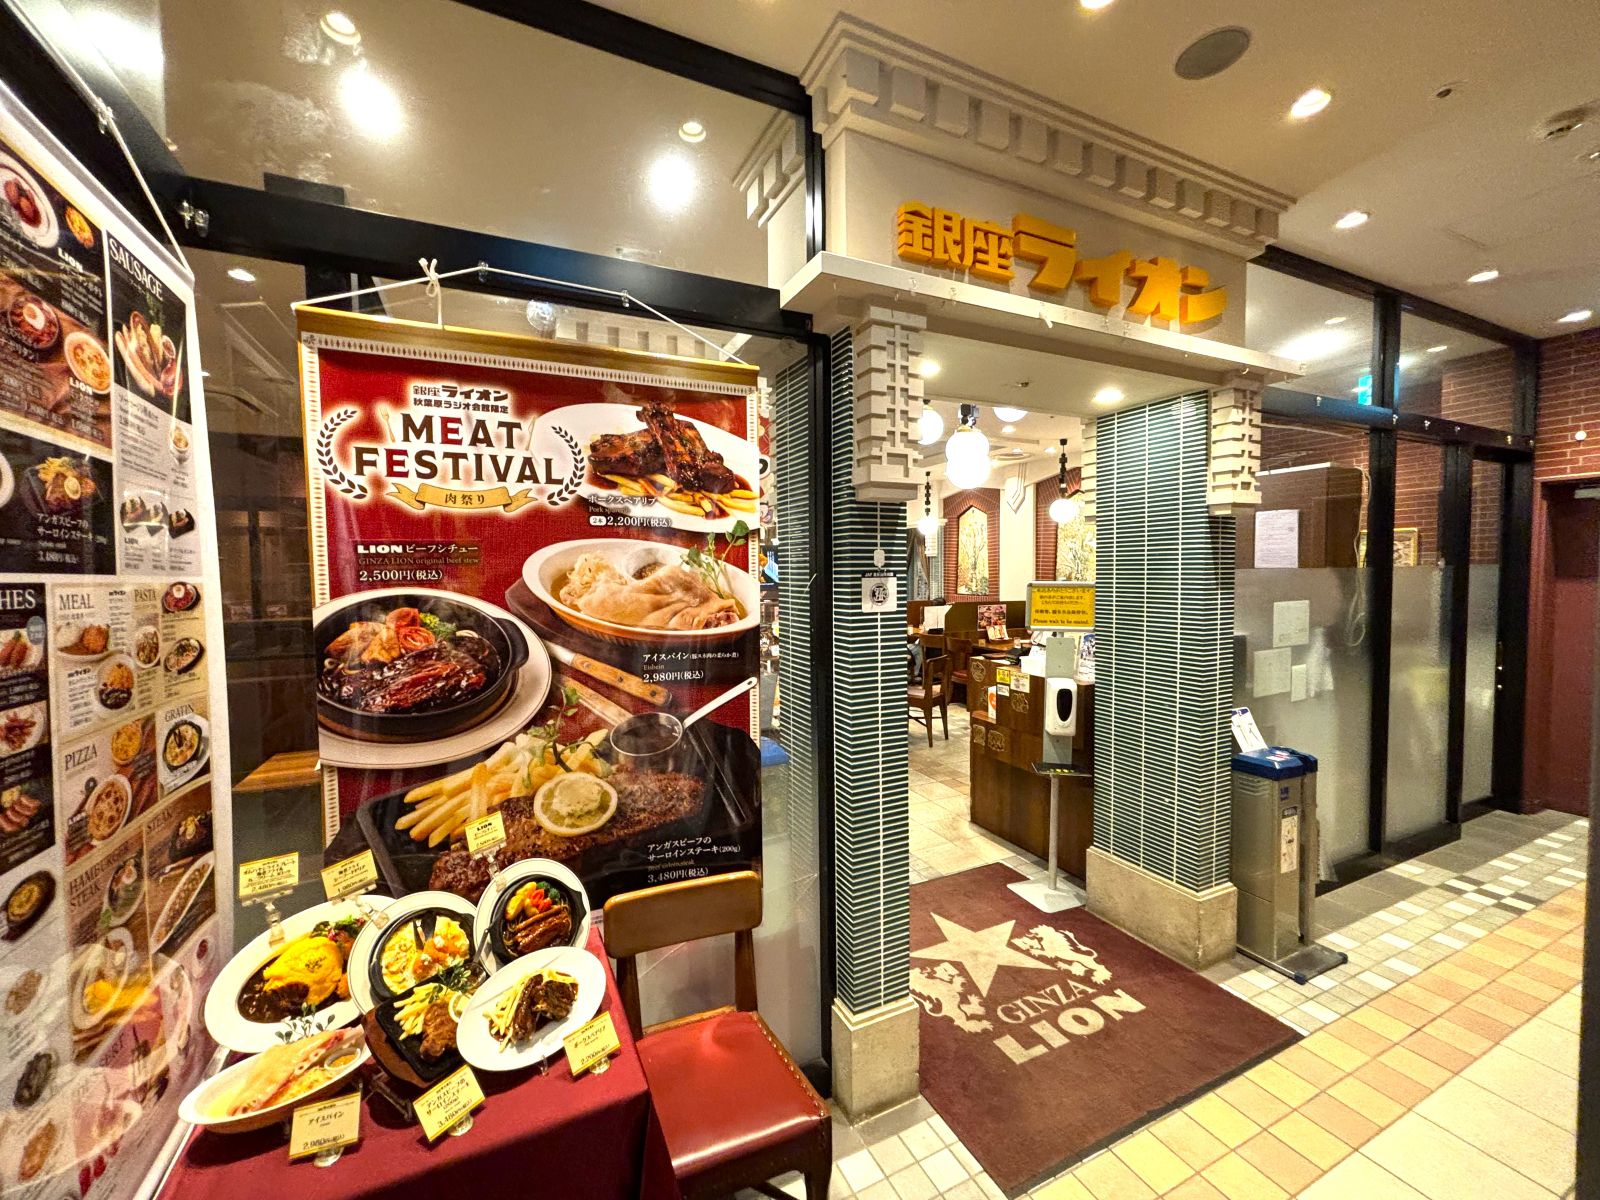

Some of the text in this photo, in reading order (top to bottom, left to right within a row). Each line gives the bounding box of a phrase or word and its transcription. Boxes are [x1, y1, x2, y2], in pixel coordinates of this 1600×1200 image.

[58, 247, 84, 273] LION
[897, 199, 1227, 325] 銀座ライオン
[109, 238, 164, 302] SAUSAGE
[69, 377, 94, 396] LION
[413, 384, 508, 402] 銀座ライオン
[413, 398, 509, 414] 秋葉原ラジオ会館限定
[401, 412, 523, 449] MEAT
[353, 445, 565, 486] FESTIVAL
[444, 492, 486, 506] 肉祭り
[588, 494, 658, 506] ポークスペアリブ
[607, 515, 673, 528] 2,200円(税込)
[357, 543, 479, 554] LION ビーフシチュー
[359, 569, 444, 582] 2,500円(税込)
[59, 592, 95, 611] MEAL
[643, 670, 704, 683] 2,980円(税込)
[64, 744, 97, 771] PIZZA
[647, 836, 712, 853] アンガスビーフの
[647, 866, 709, 883] 3,480円(税込)
[996, 979, 1098, 1025] GINZA
[992, 988, 1147, 1066] LION
